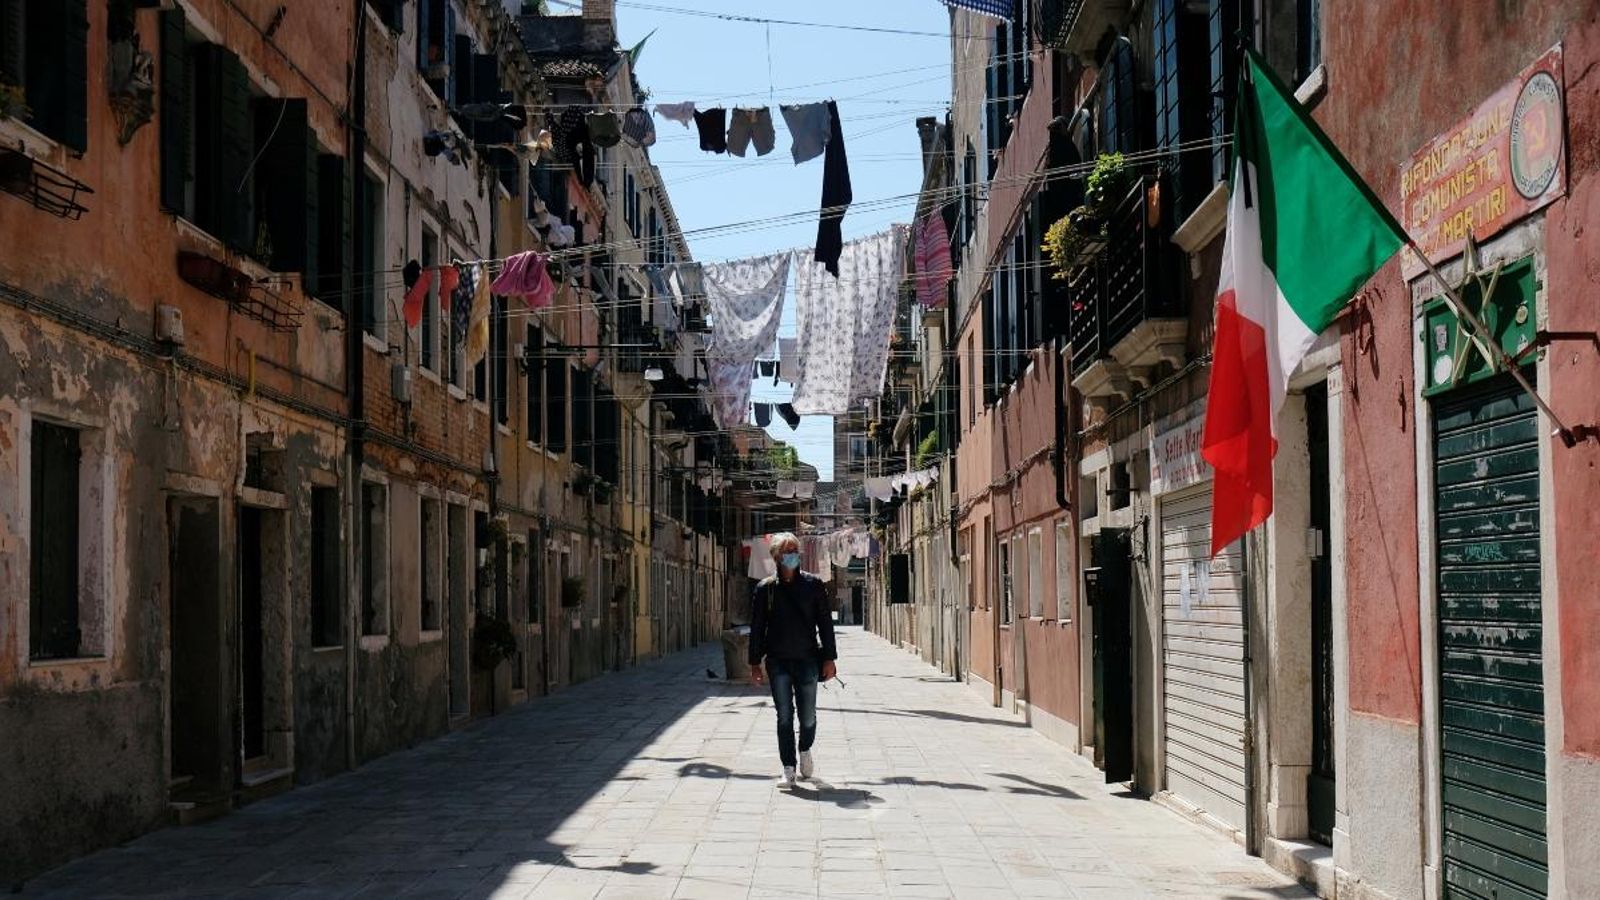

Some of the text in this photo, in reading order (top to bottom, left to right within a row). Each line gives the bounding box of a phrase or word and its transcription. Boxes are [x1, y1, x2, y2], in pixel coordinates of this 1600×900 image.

[1401, 103, 1510, 198] RIFONDAZIONE
[1412, 147, 1498, 227] COMUNISTA
[1443, 184, 1508, 244] MARTIRI
